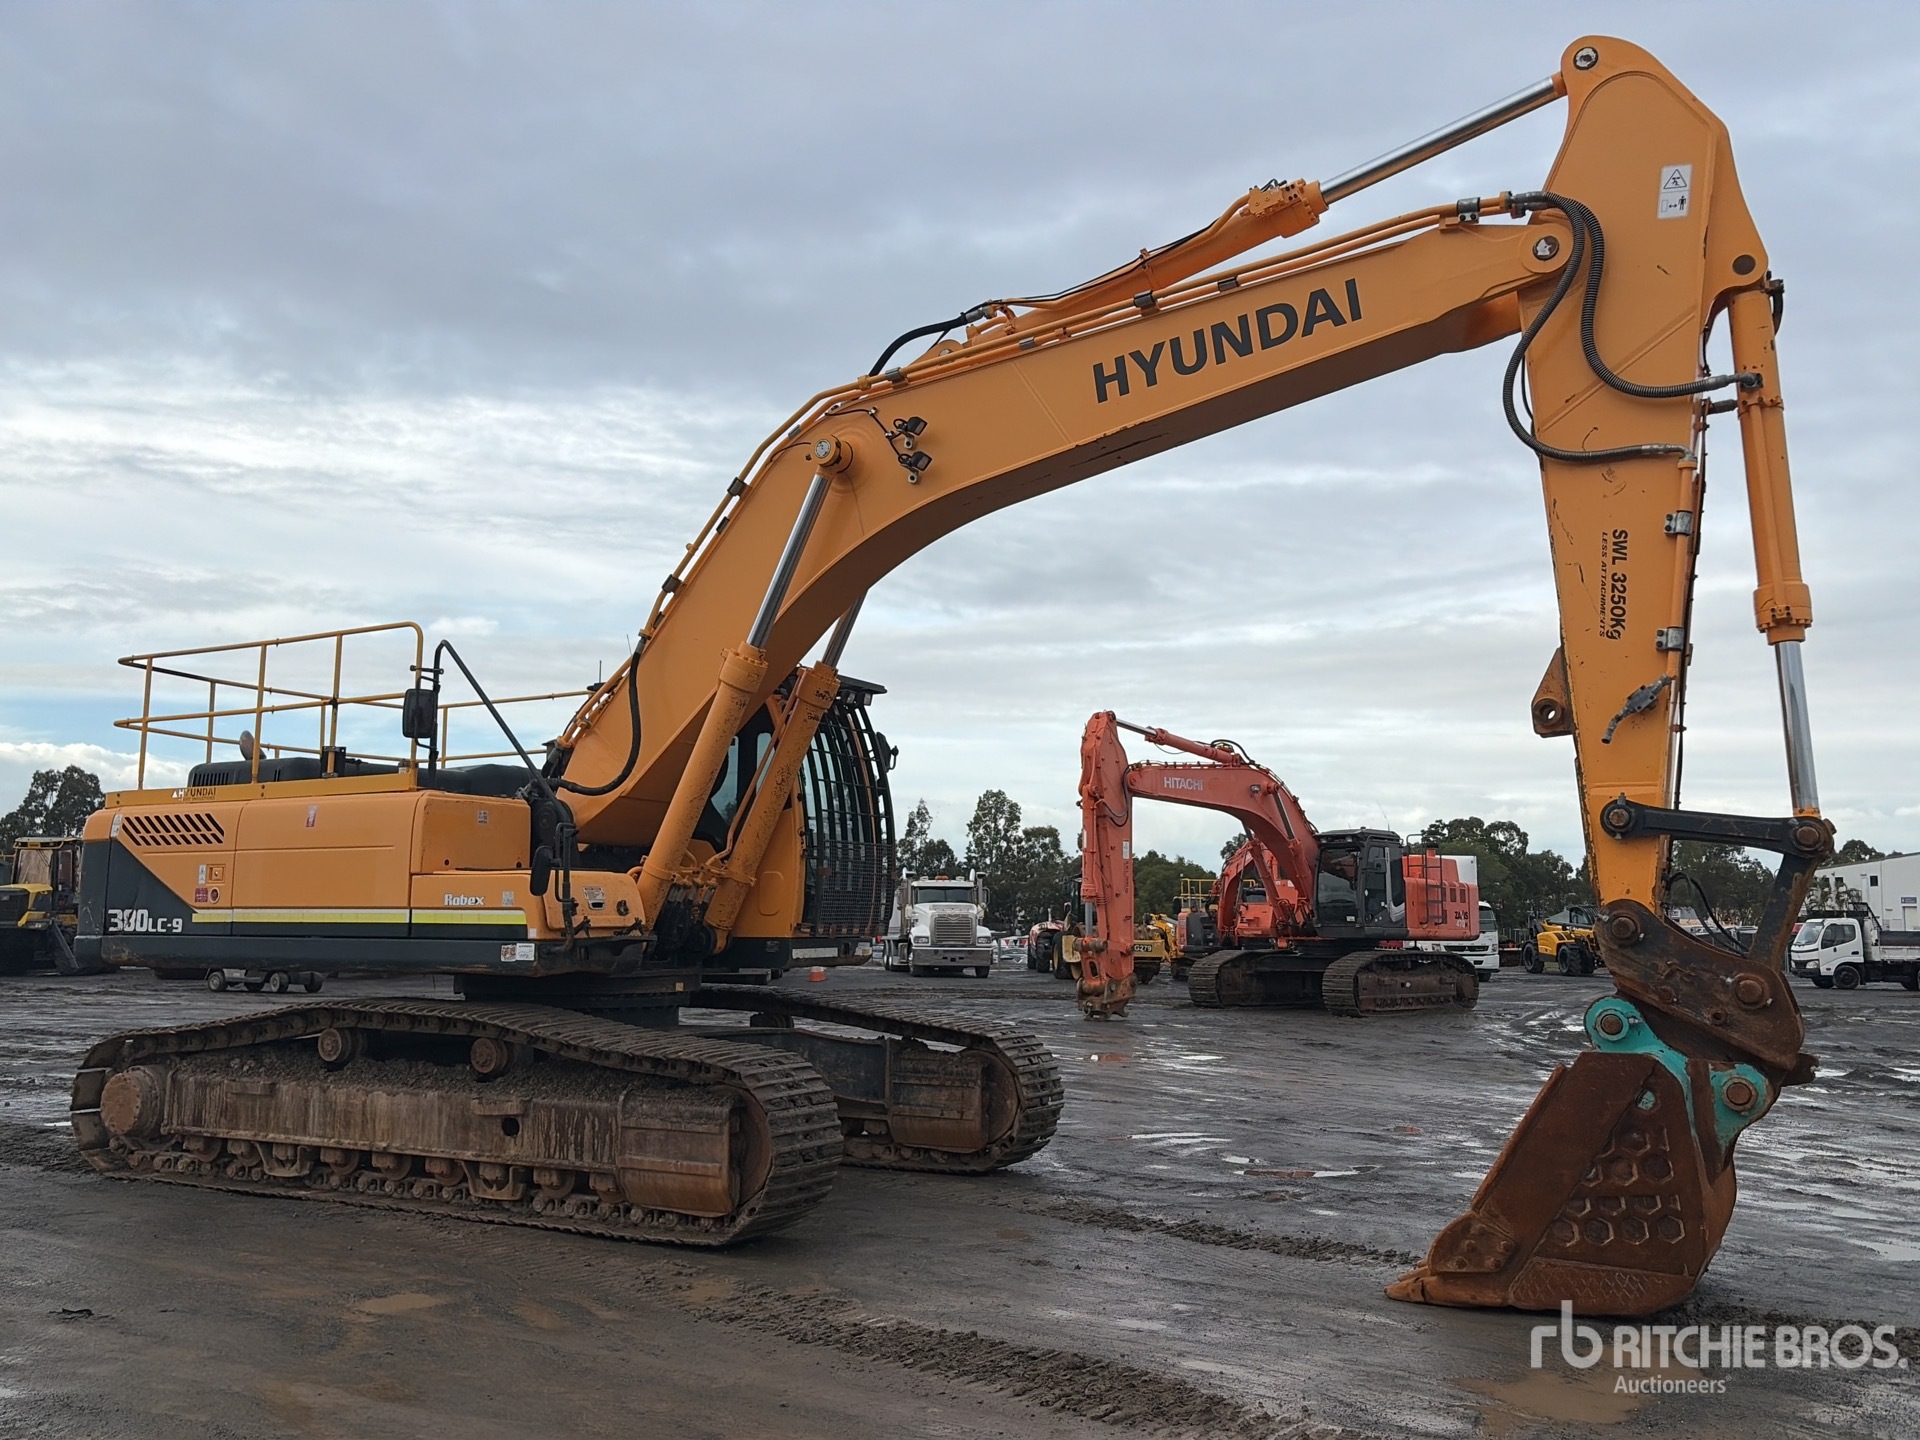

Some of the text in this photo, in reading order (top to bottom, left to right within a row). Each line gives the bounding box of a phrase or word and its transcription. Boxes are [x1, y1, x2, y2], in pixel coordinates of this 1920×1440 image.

[1092, 278, 1363, 404] HYUNDAI
[1606, 529, 1629, 640] SWL 3250Kg
[1163, 776, 1203, 790] HITACHI
[178, 787, 216, 797] HYUNDAI
[444, 893, 484, 906] Robex
[1134, 944, 1152, 952] G279
